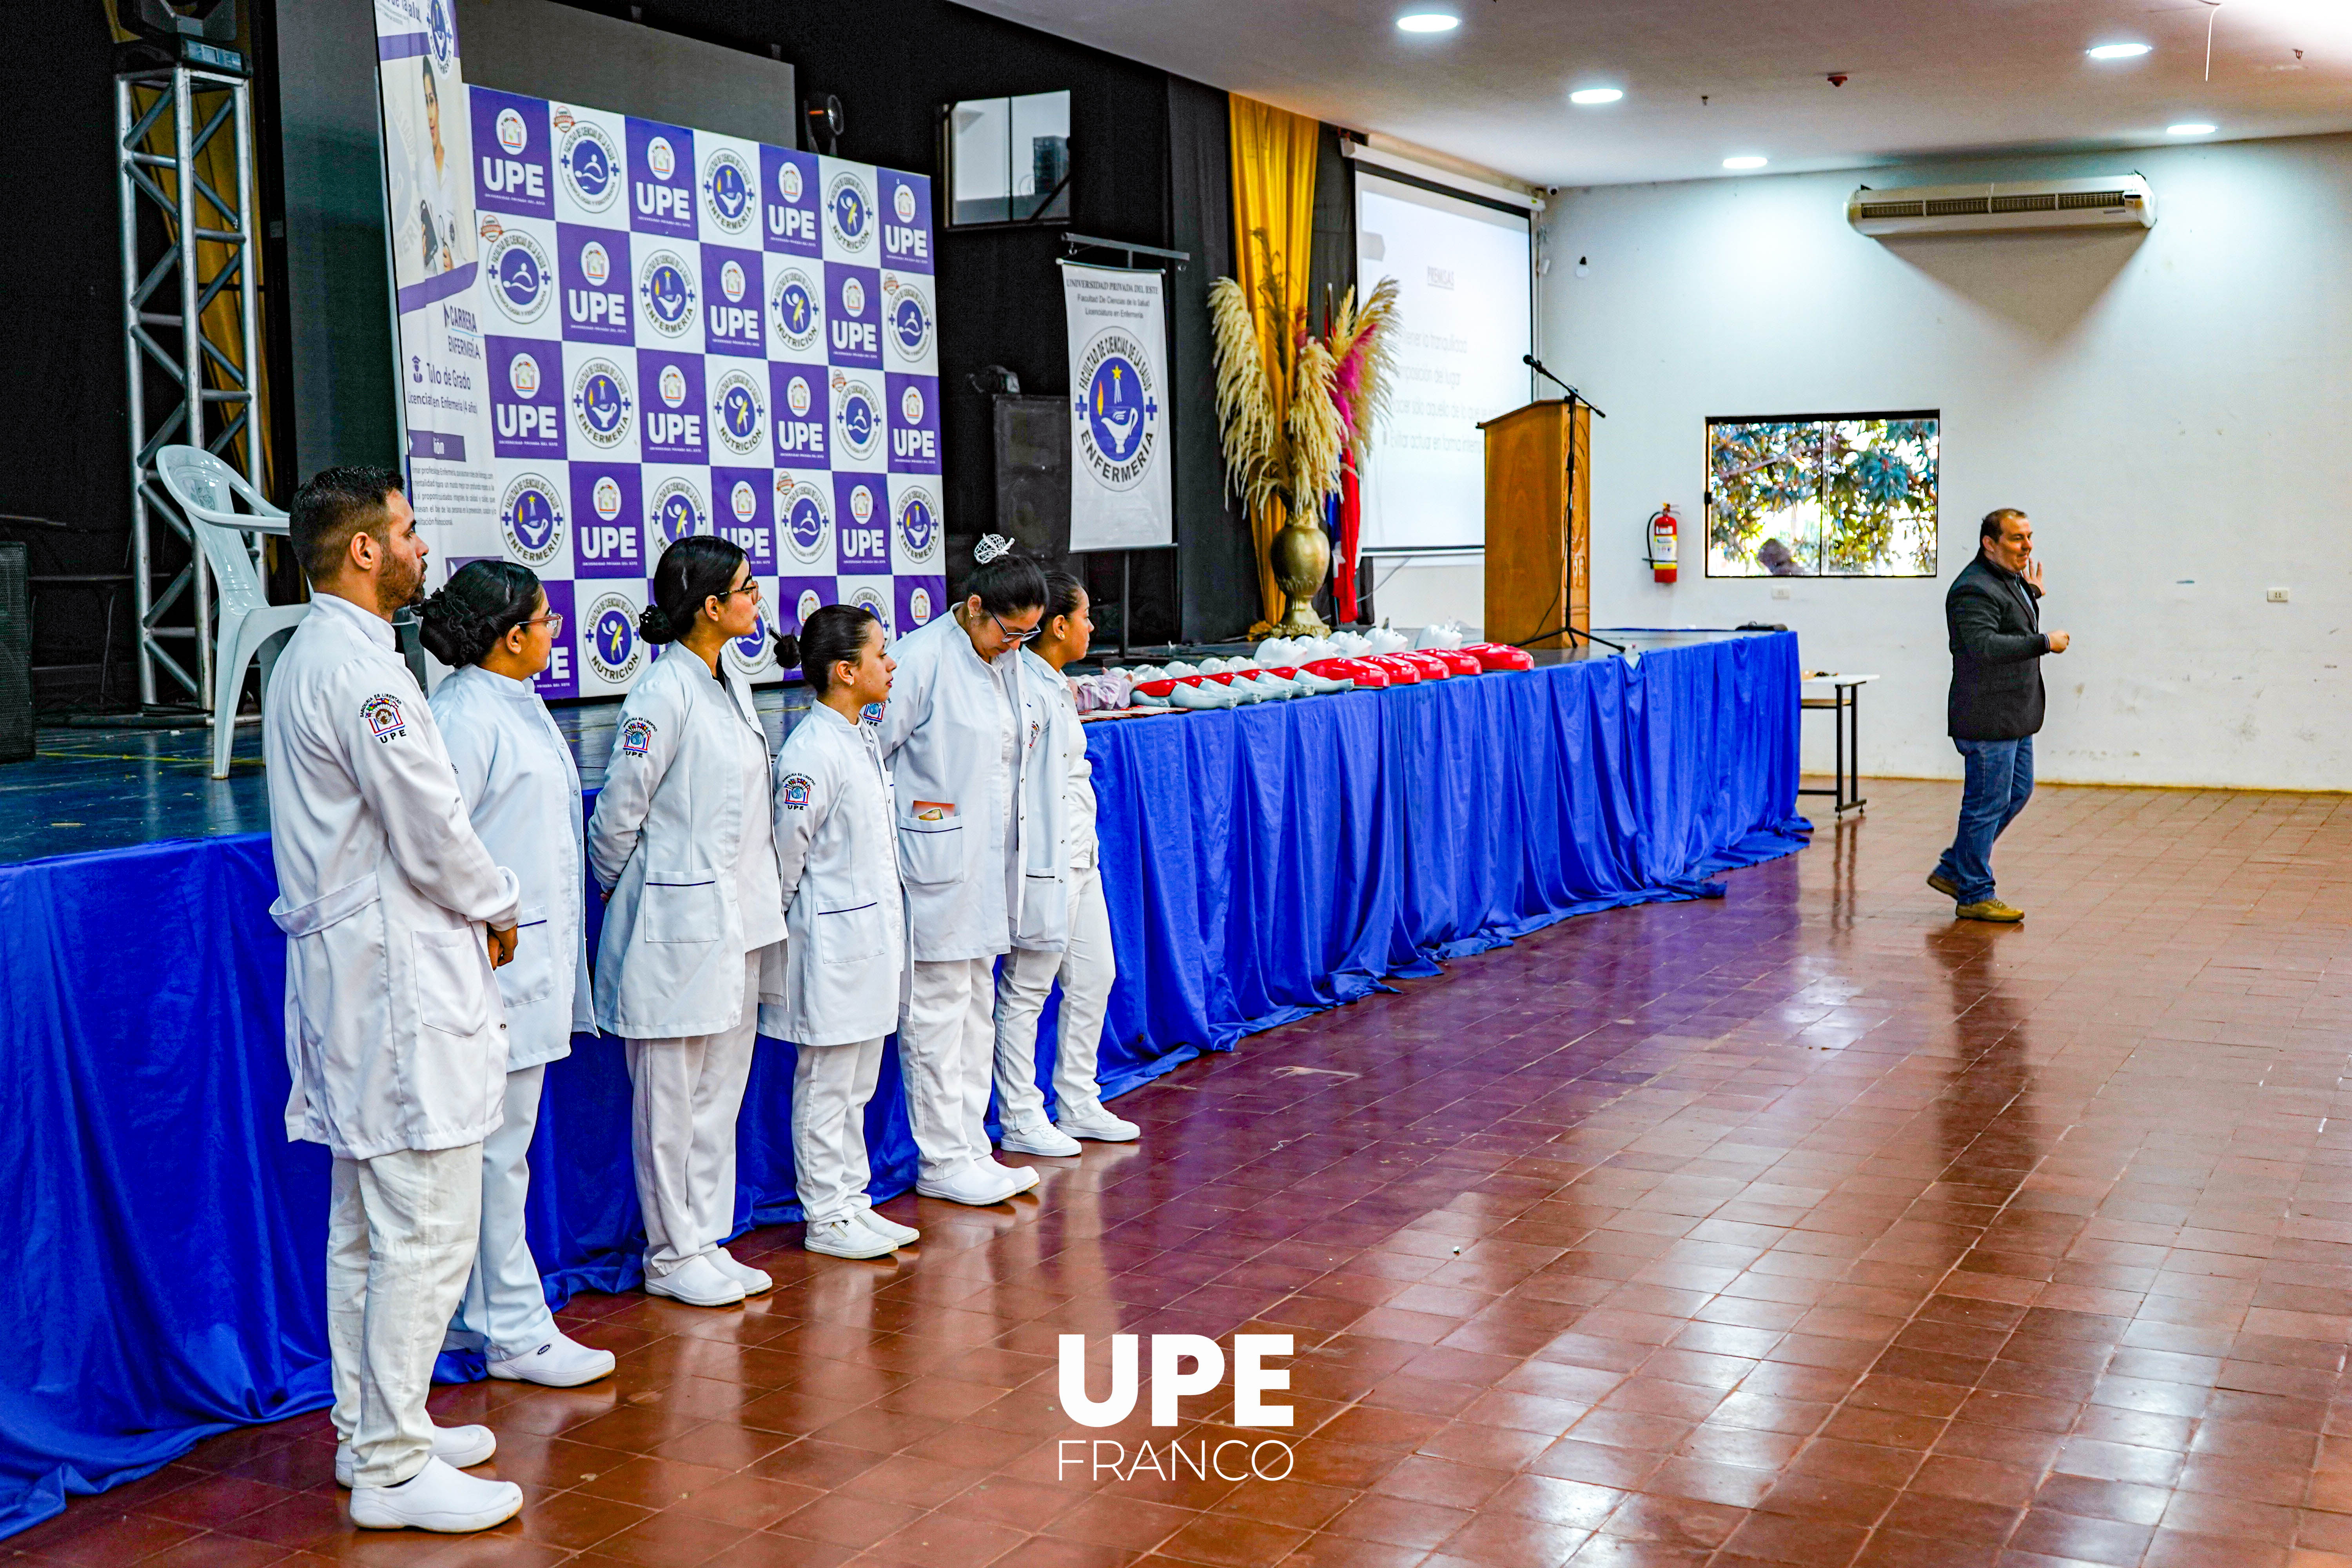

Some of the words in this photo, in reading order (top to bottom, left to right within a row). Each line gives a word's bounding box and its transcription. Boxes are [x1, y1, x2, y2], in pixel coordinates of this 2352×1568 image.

[483, 157, 544, 197] UPE
[636, 182, 690, 220] UPE
[708, 198, 752, 229] ENFERMERÍA
[769, 205, 815, 240] UPE
[832, 224, 869, 249] NUTRICIÓN
[885, 225, 927, 257] UPE
[1066, 279, 1108, 290] UNIVERSIDAD
[1110, 283, 1133, 292] PRIVADA
[1134, 285, 1144, 293] DEL
[1145, 286, 1158, 294] ESTE
[1427, 266, 1454, 287] PREMISAS
[569, 289, 626, 325] UPE
[645, 301, 692, 332] ENFERMERÍA
[710, 305, 759, 339] UPE
[777, 321, 816, 347] NUTRICIÓN
[832, 320, 877, 351] UPE
[1430, 330, 1467, 353] tranquilidad
[444, 367, 451, 386] de
[452, 370, 470, 390] Grado
[1079, 348, 1099, 391] FACULTAD
[1098, 340, 1106, 359] DE
[1105, 336, 1128, 354] CIENCIAS
[1128, 343, 1136, 361] DE
[1134, 351, 1142, 367] LA
[1139, 362, 1152, 392] SALUD
[497, 404, 557, 438] UPE
[578, 412, 628, 443] ENFERMERÍA
[648, 413, 701, 445] UPE
[779, 421, 823, 451] UPE
[719, 425, 761, 450] NUTRICIÓN
[893, 429, 935, 457] UPE
[1081, 430, 1153, 483] ENFERMERÍA
[517, 480, 524, 491] DE
[544, 485, 551, 496] LA
[507, 530, 560, 561] ENFERMERÍA
[581, 527, 637, 558] UPE
[842, 529, 885, 557] UPE
[591, 652, 639, 679] NUTRICIÓN
[382, 693, 401, 705] LIBERTAD
[379, 730, 407, 744] UPE
